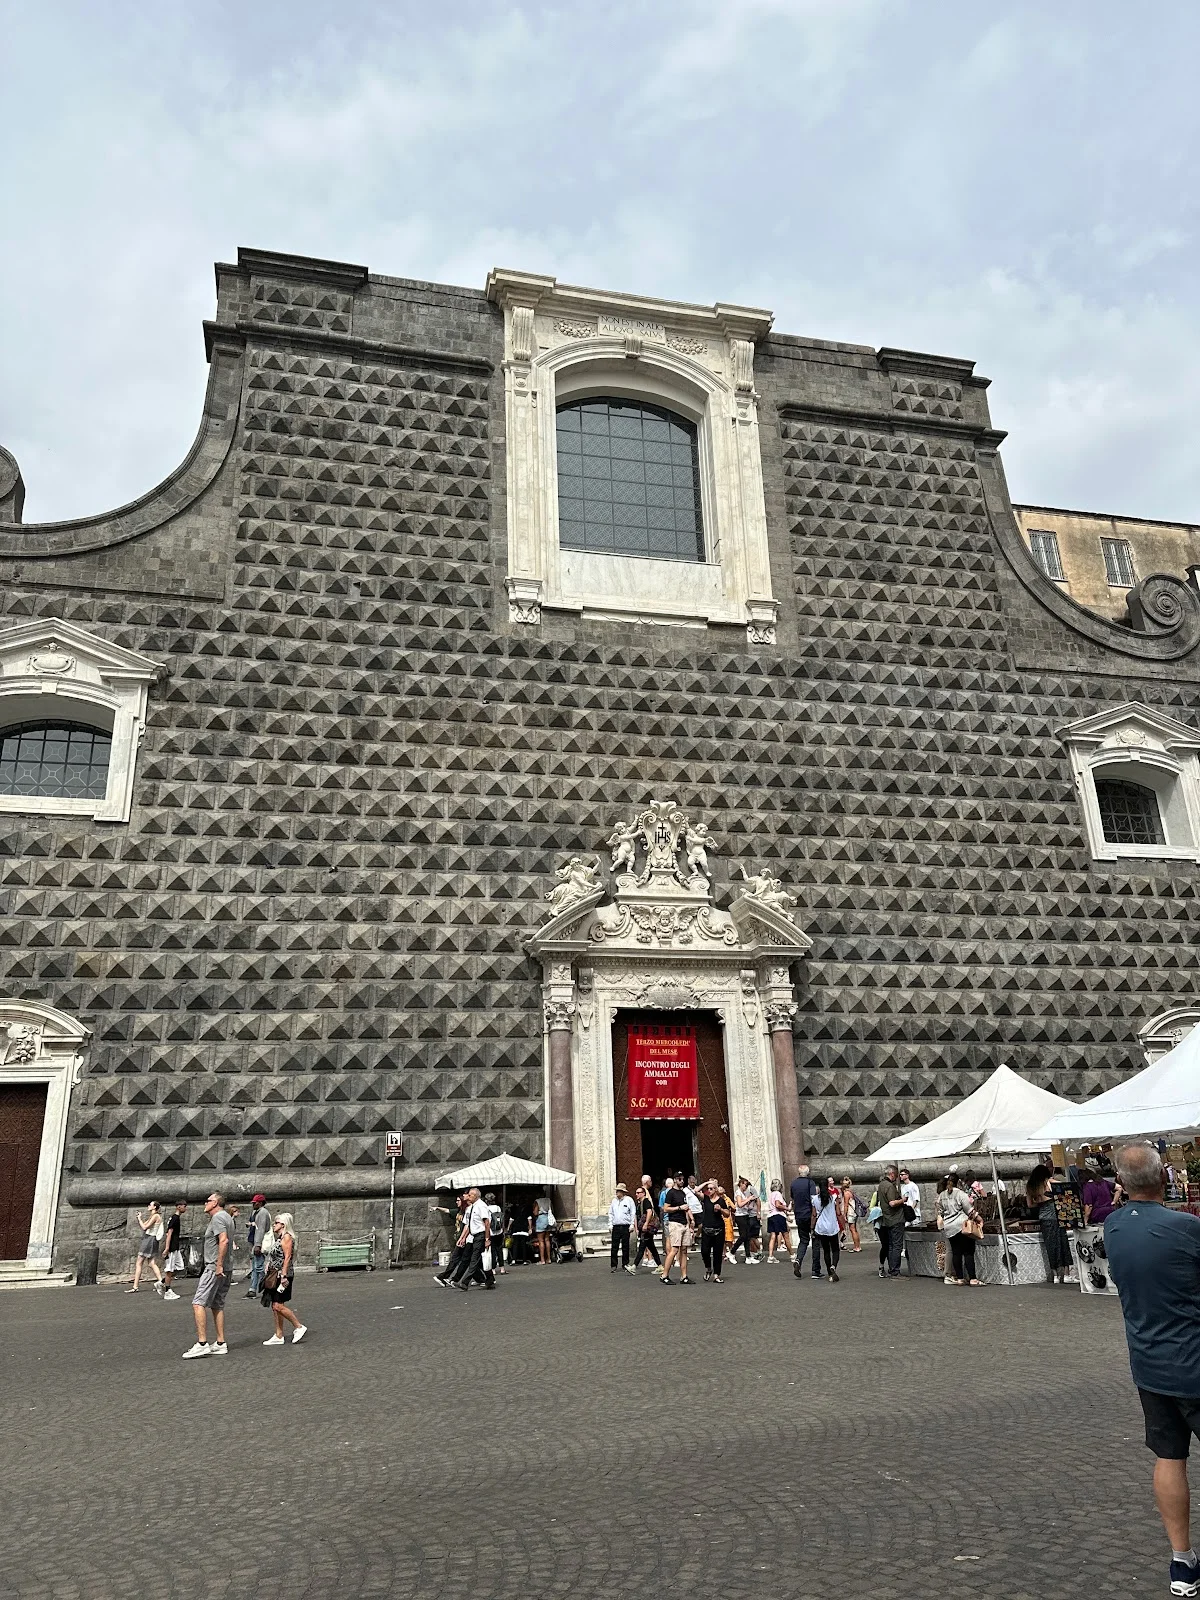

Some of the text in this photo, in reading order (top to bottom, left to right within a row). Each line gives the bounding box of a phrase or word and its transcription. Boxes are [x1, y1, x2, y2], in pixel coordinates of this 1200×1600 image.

[602, 316, 620, 324] NON
[622, 318, 634, 326] EST
[654, 832, 671, 844] IHS
[656, 1098, 697, 1108] MOSCATI
